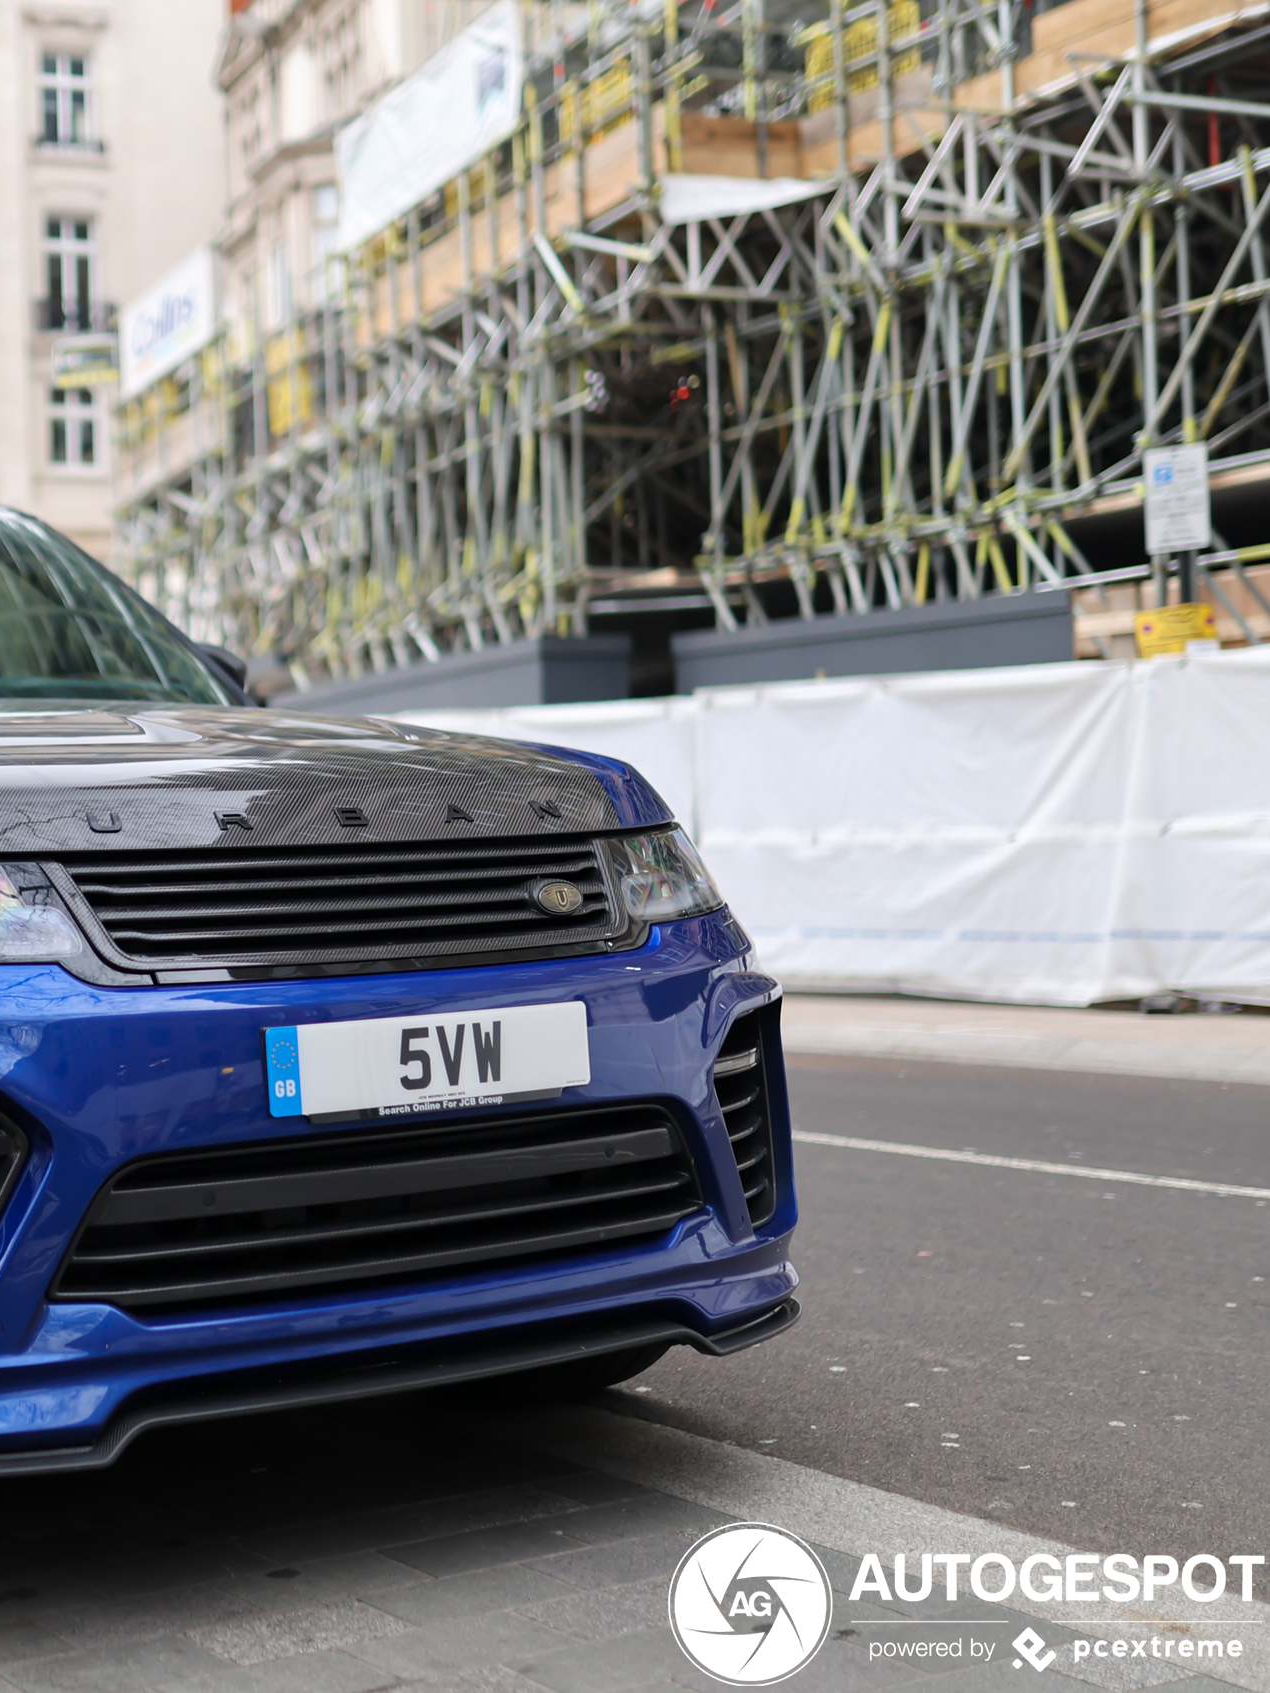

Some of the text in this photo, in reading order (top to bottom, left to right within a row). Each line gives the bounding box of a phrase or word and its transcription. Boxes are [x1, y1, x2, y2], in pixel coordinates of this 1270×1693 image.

[86, 799, 562, 833] URBAN
[399, 1020, 501, 1091] 5VW
[274, 1079, 297, 1098] GB
[379, 1095, 503, 1116] Search Online For JCB Group
